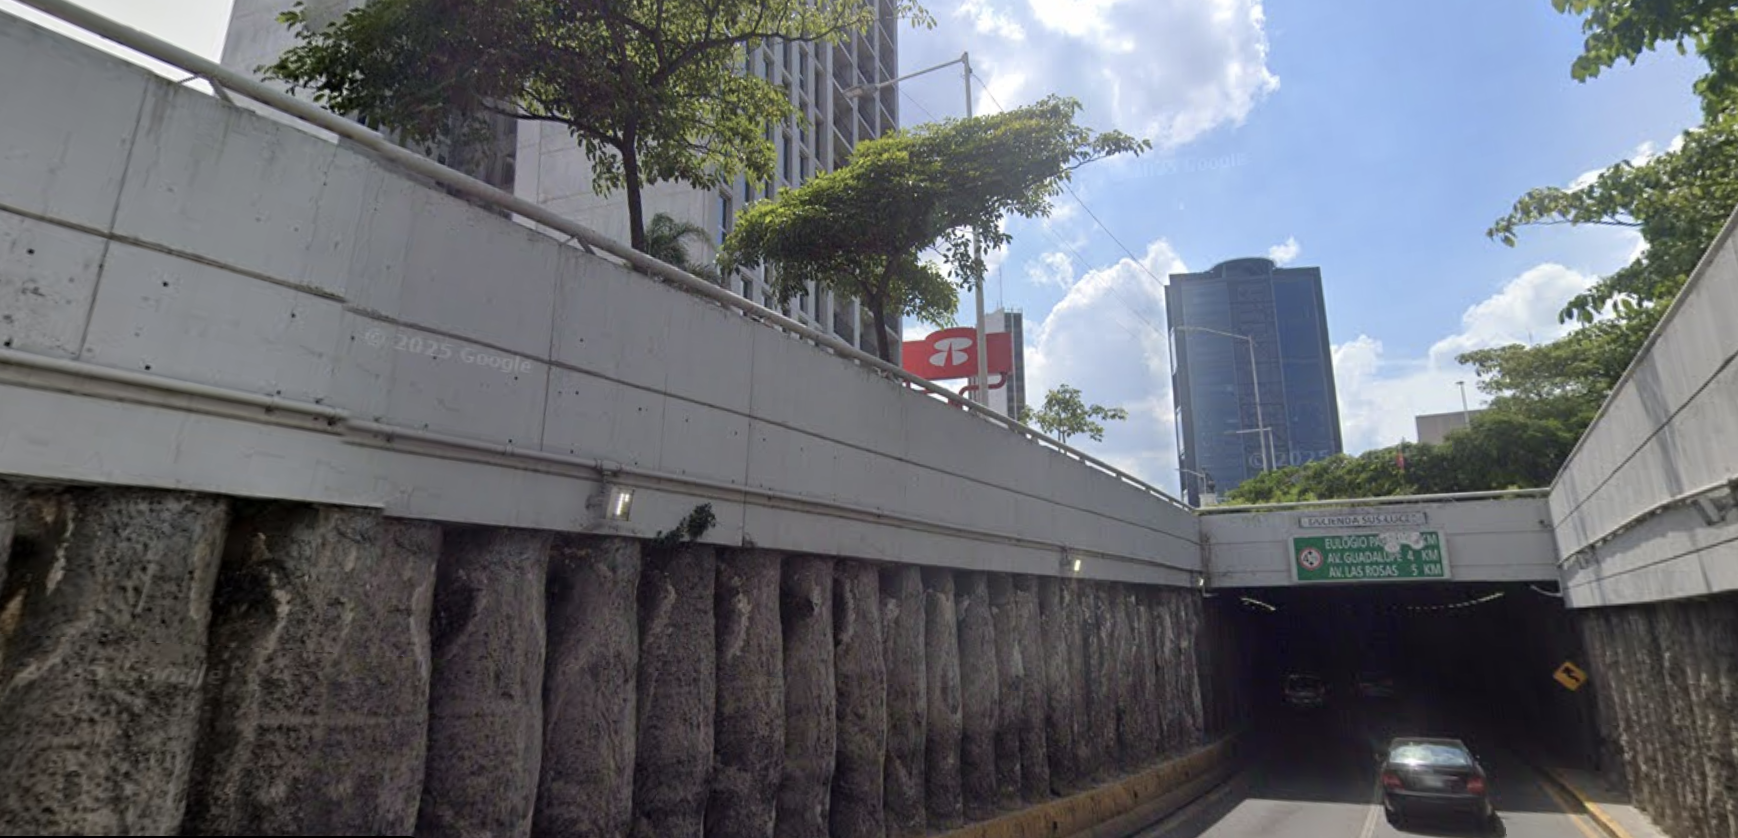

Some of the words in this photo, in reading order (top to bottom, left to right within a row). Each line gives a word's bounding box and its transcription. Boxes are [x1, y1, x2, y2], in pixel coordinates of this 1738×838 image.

[1362, 514, 1382, 524] SUS
[1343, 549, 1402, 563] GUADALUPE
[1407, 550, 1414, 561] 4
[1421, 549, 1439, 561] KM
[1329, 566, 1344, 578] AV.
[1346, 565, 1363, 577] LAS
[1365, 564, 1398, 577] ROSAS
[1412, 565, 1418, 576] 5
[1423, 563, 1442, 576] KM
